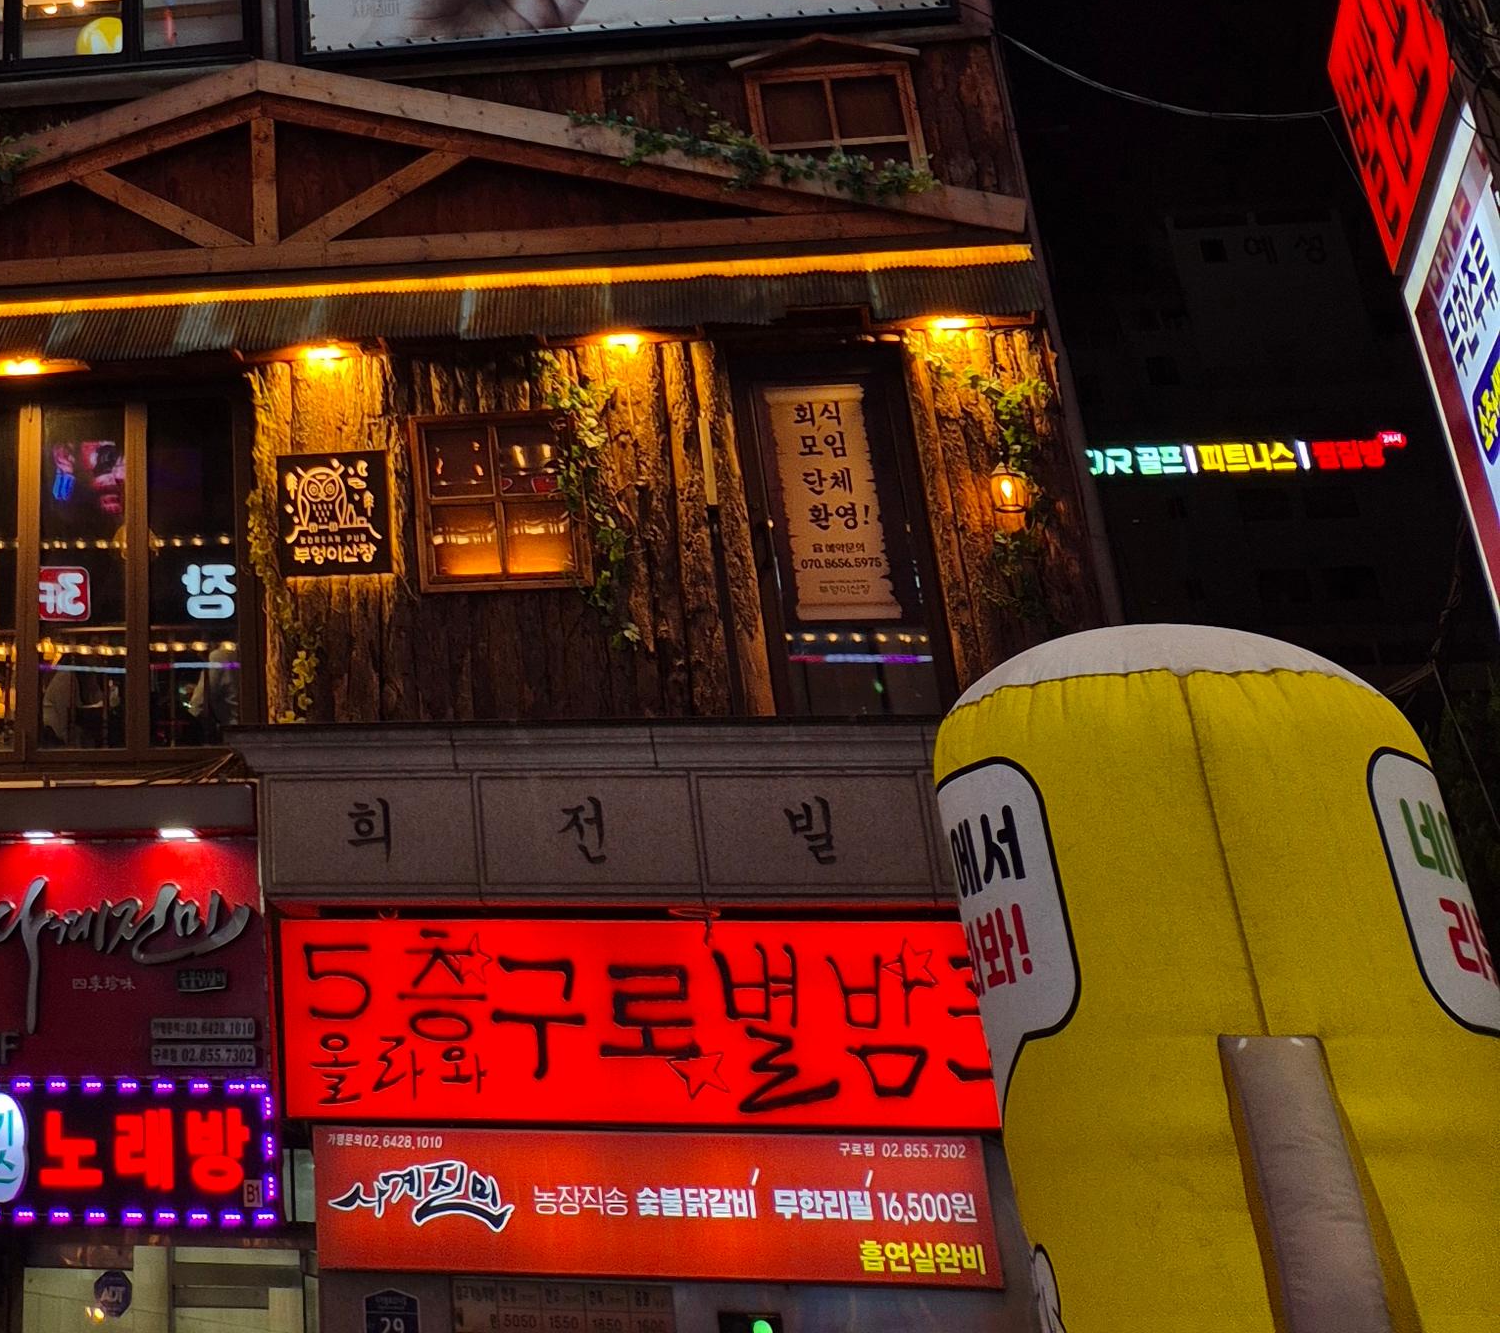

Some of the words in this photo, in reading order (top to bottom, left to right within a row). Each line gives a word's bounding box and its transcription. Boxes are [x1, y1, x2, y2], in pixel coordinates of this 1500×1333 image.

[793, 400, 842, 426] 회식
[798, 430, 848, 458] 모임
[1135, 445, 1188, 475] 골프
[1197, 441, 1298, 473] 피트니스
[802, 467, 853, 495] 단체
[808, 501, 870, 530] 환영!
[293, 542, 377, 565] 부엉이산장
[801, 556, 882, 570] 070.8656.5975
[308, 1033, 489, 1108] 올라와
[39, 1106, 251, 1193] 노래방
[838, 1141, 876, 1159] 구로점
[881, 1141, 968, 1161] 02.855.7302
[328, 1159, 517, 1234] 사계진미
[532, 1184, 629, 1218] 농장직송
[635, 1185, 758, 1220] 숯불닭갈비
[773, 1186, 875, 1223] 무한리필
[879, 1191, 978, 1226] 16,500원
[858, 1240, 987, 1276] 흡연실완비
[100, 1285, 126, 1304] ADT
